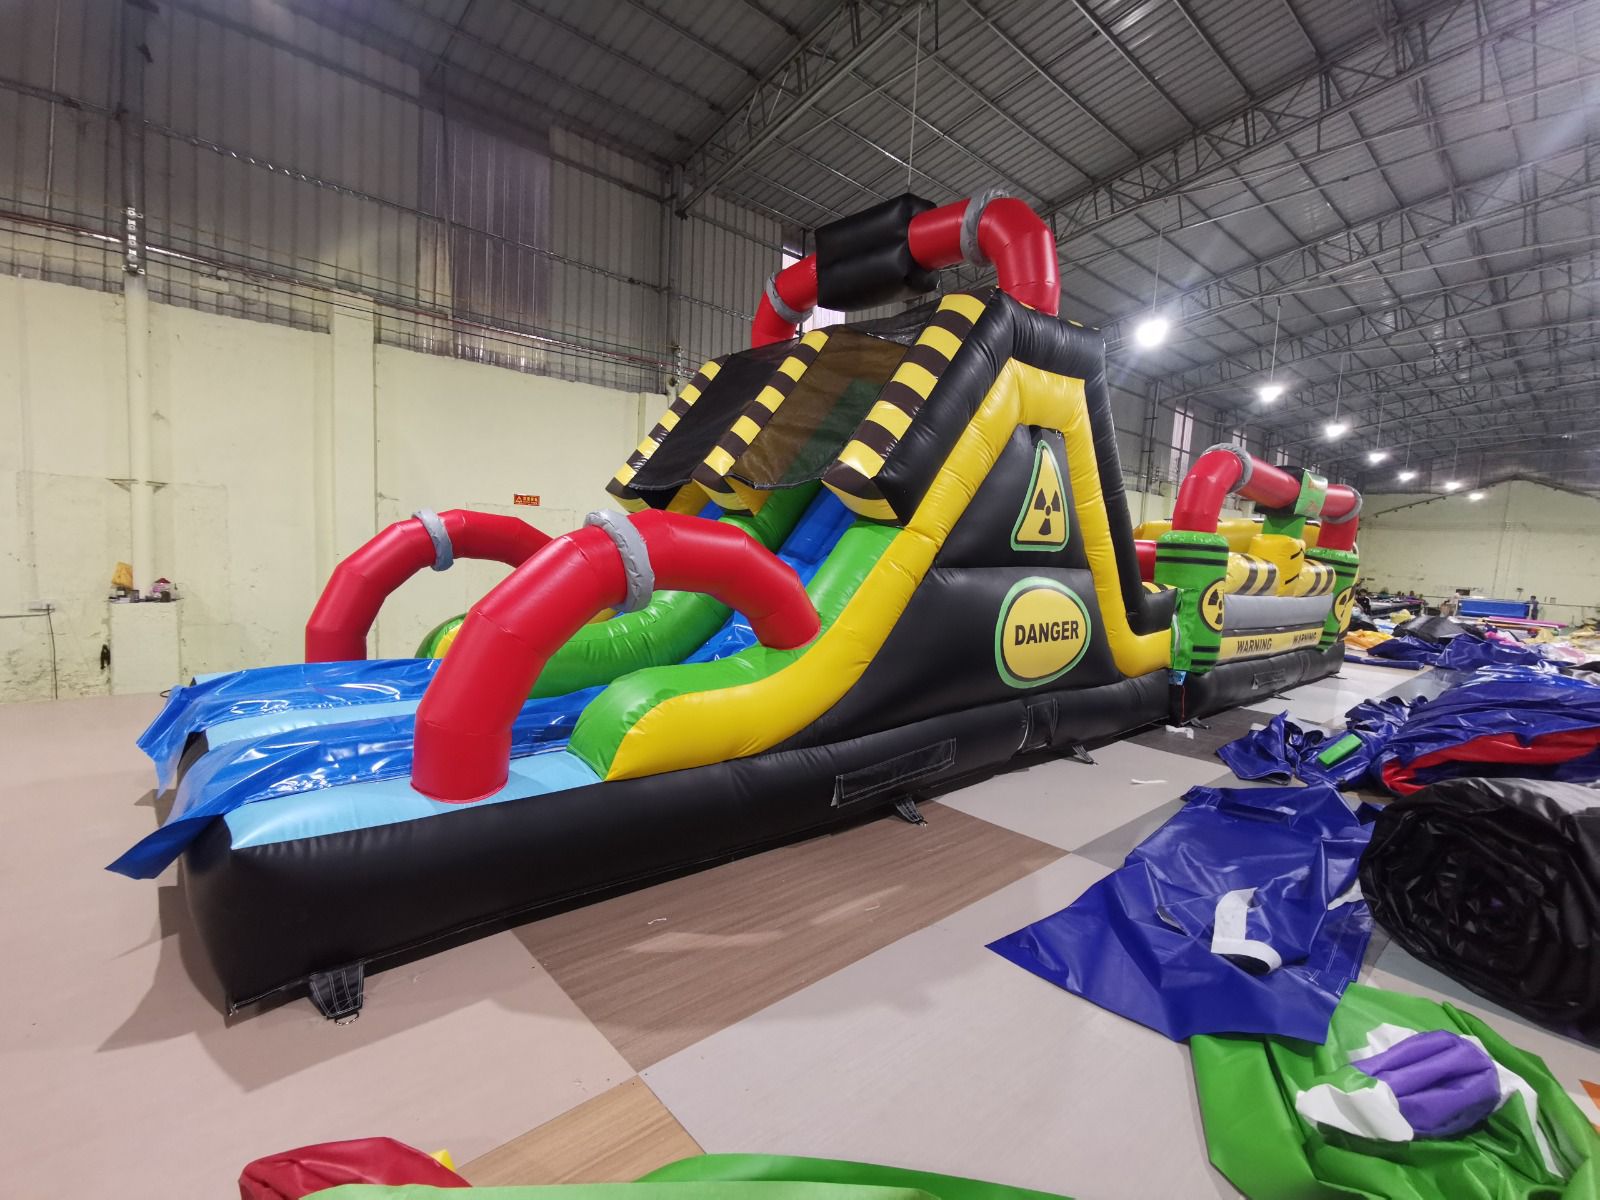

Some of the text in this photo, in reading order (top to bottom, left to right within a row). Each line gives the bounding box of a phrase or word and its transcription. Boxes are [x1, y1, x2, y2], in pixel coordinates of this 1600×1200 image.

[1015, 620, 1079, 646] DANGER
[1236, 632, 1317, 654] WARNING WARNING
